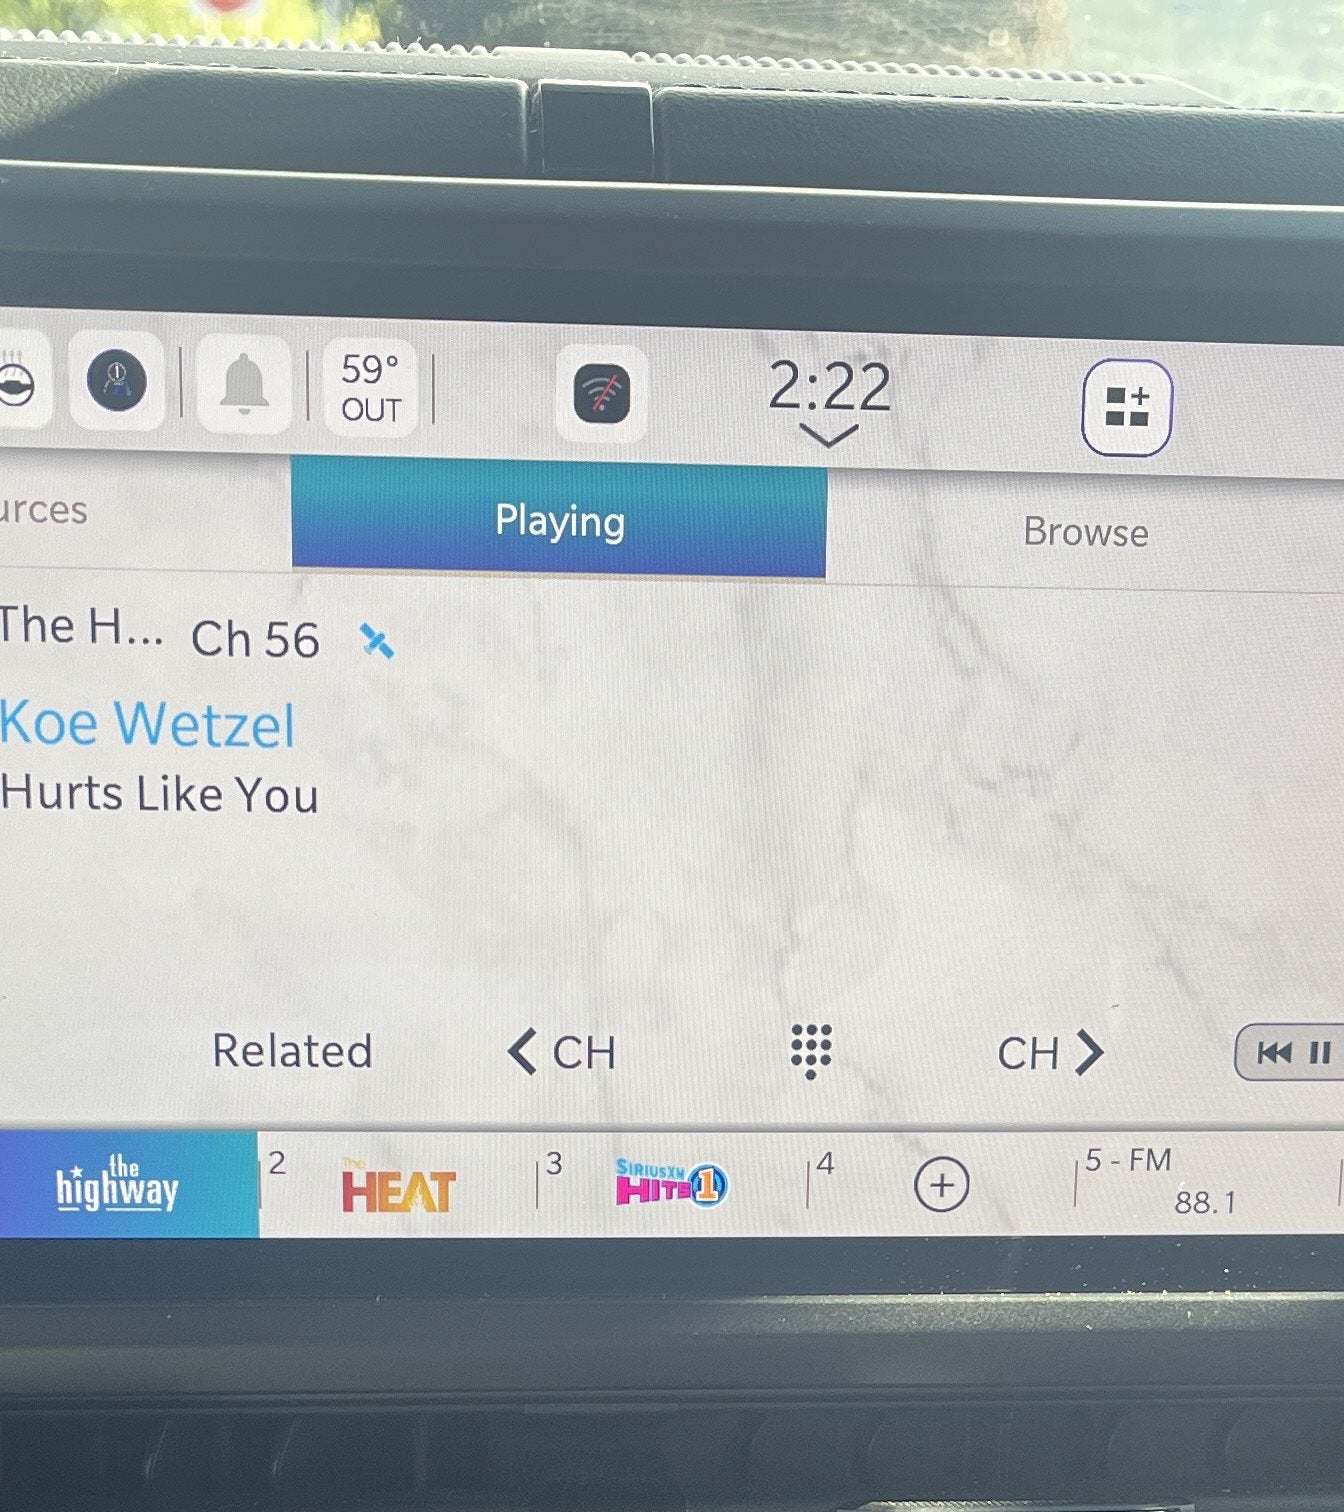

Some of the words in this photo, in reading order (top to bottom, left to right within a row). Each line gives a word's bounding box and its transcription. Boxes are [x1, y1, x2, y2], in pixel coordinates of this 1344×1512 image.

[341, 354, 399, 386] 59°
[769, 359, 891, 412] 2:22
[341, 397, 402, 423] OUT
[496, 503, 626, 545] Playing
[1024, 515, 1149, 549] Browse
[192, 620, 251, 657] Ch
[266, 622, 320, 659] 56
[0, 700, 97, 746] Koe
[114, 701, 295, 749] Wetzel
[1, 773, 123, 811] Hurts
[138, 775, 223, 813] Like
[235, 776, 318, 814] You
[214, 1032, 372, 1069] Related
[554, 1035, 615, 1069] CH
[999, 1036, 1058, 1070] CH
[109, 1154, 139, 1178] the
[268, 1150, 286, 1175] 2
[546, 1151, 563, 1175] 3
[817, 1151, 834, 1175] 4
[1085, 1149, 1101, 1172] 5
[1130, 1148, 1172, 1172] FM
[56, 1165, 179, 1212] highway
[343, 1171, 457, 1213] HEAT
[616, 1175, 692, 1206] HITS
[695, 1166, 720, 1202] 1
[1175, 1190, 1236, 1216] 88.1
